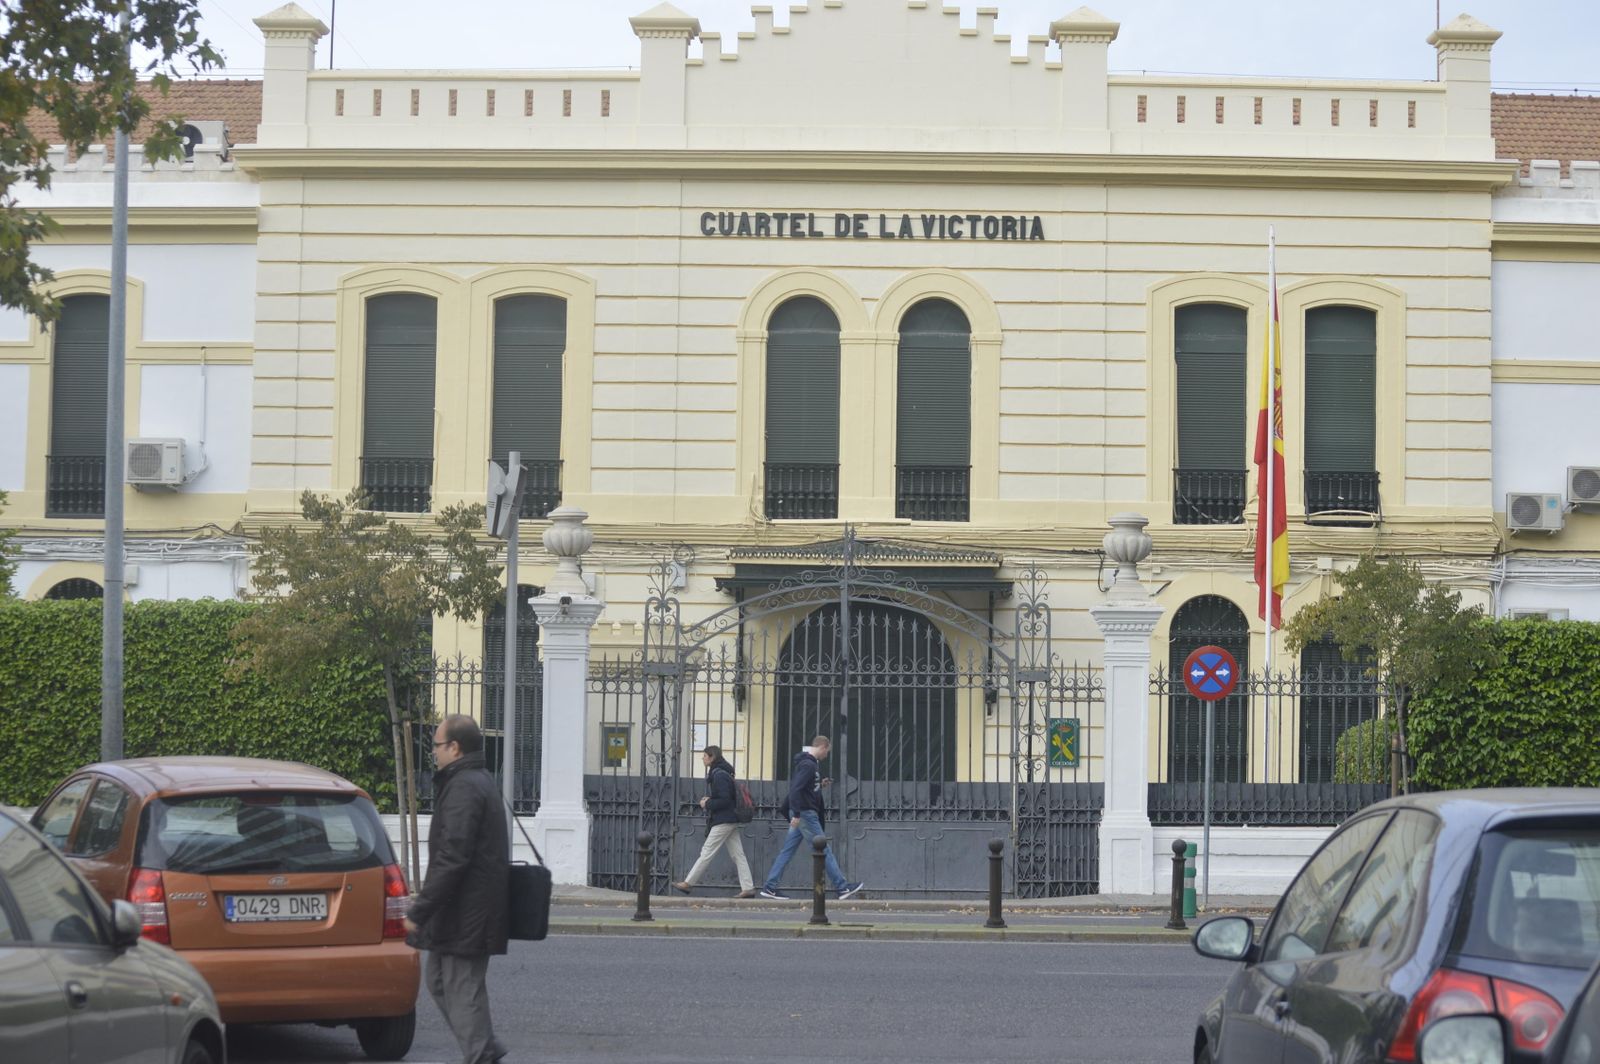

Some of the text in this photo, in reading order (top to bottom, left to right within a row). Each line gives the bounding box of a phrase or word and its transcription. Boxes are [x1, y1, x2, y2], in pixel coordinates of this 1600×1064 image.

[700, 211, 1045, 241] CUARTEL DE LA VICTORIA
[237, 898, 280, 915] 0429
[289, 897, 321, 914] DNR
